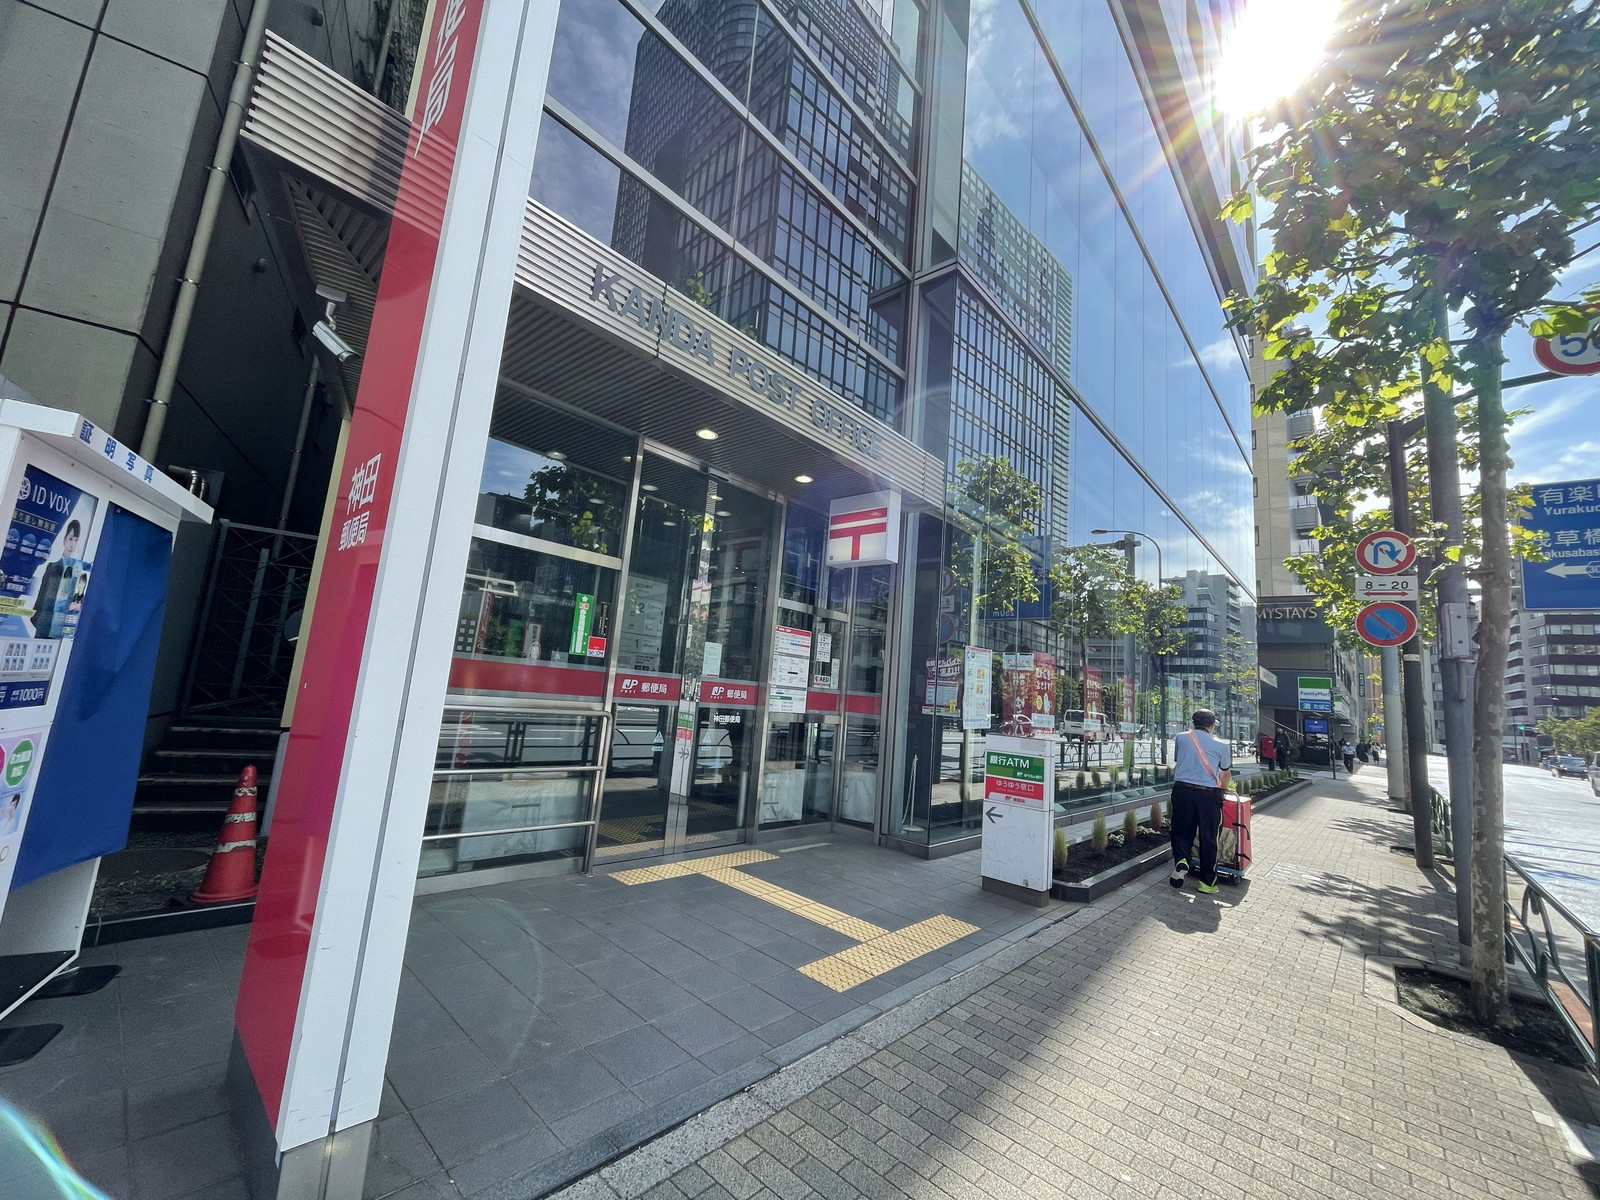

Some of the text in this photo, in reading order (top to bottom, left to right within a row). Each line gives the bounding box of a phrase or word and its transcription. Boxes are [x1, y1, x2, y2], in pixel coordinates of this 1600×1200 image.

[590, 264, 881, 460] KANDA POST OFFICE
[80, 419, 155, 484] 証明写真
[346, 453, 381, 515] 神田
[32, 484, 72, 516] ID VOX
[1539, 484, 1600, 506] 有楽
[338, 511, 370, 551] 郵便局
[1256, 606, 1318, 619] MYSTAYS
[641, 682, 667, 695] 郵便局
[726, 688, 748, 700] 郵便局
[713, 714, 740, 724] 神田郵便局
[989, 754, 1030, 769] 銀行ATM
[995, 780, 1034, 792] ゆうゆう窓口
